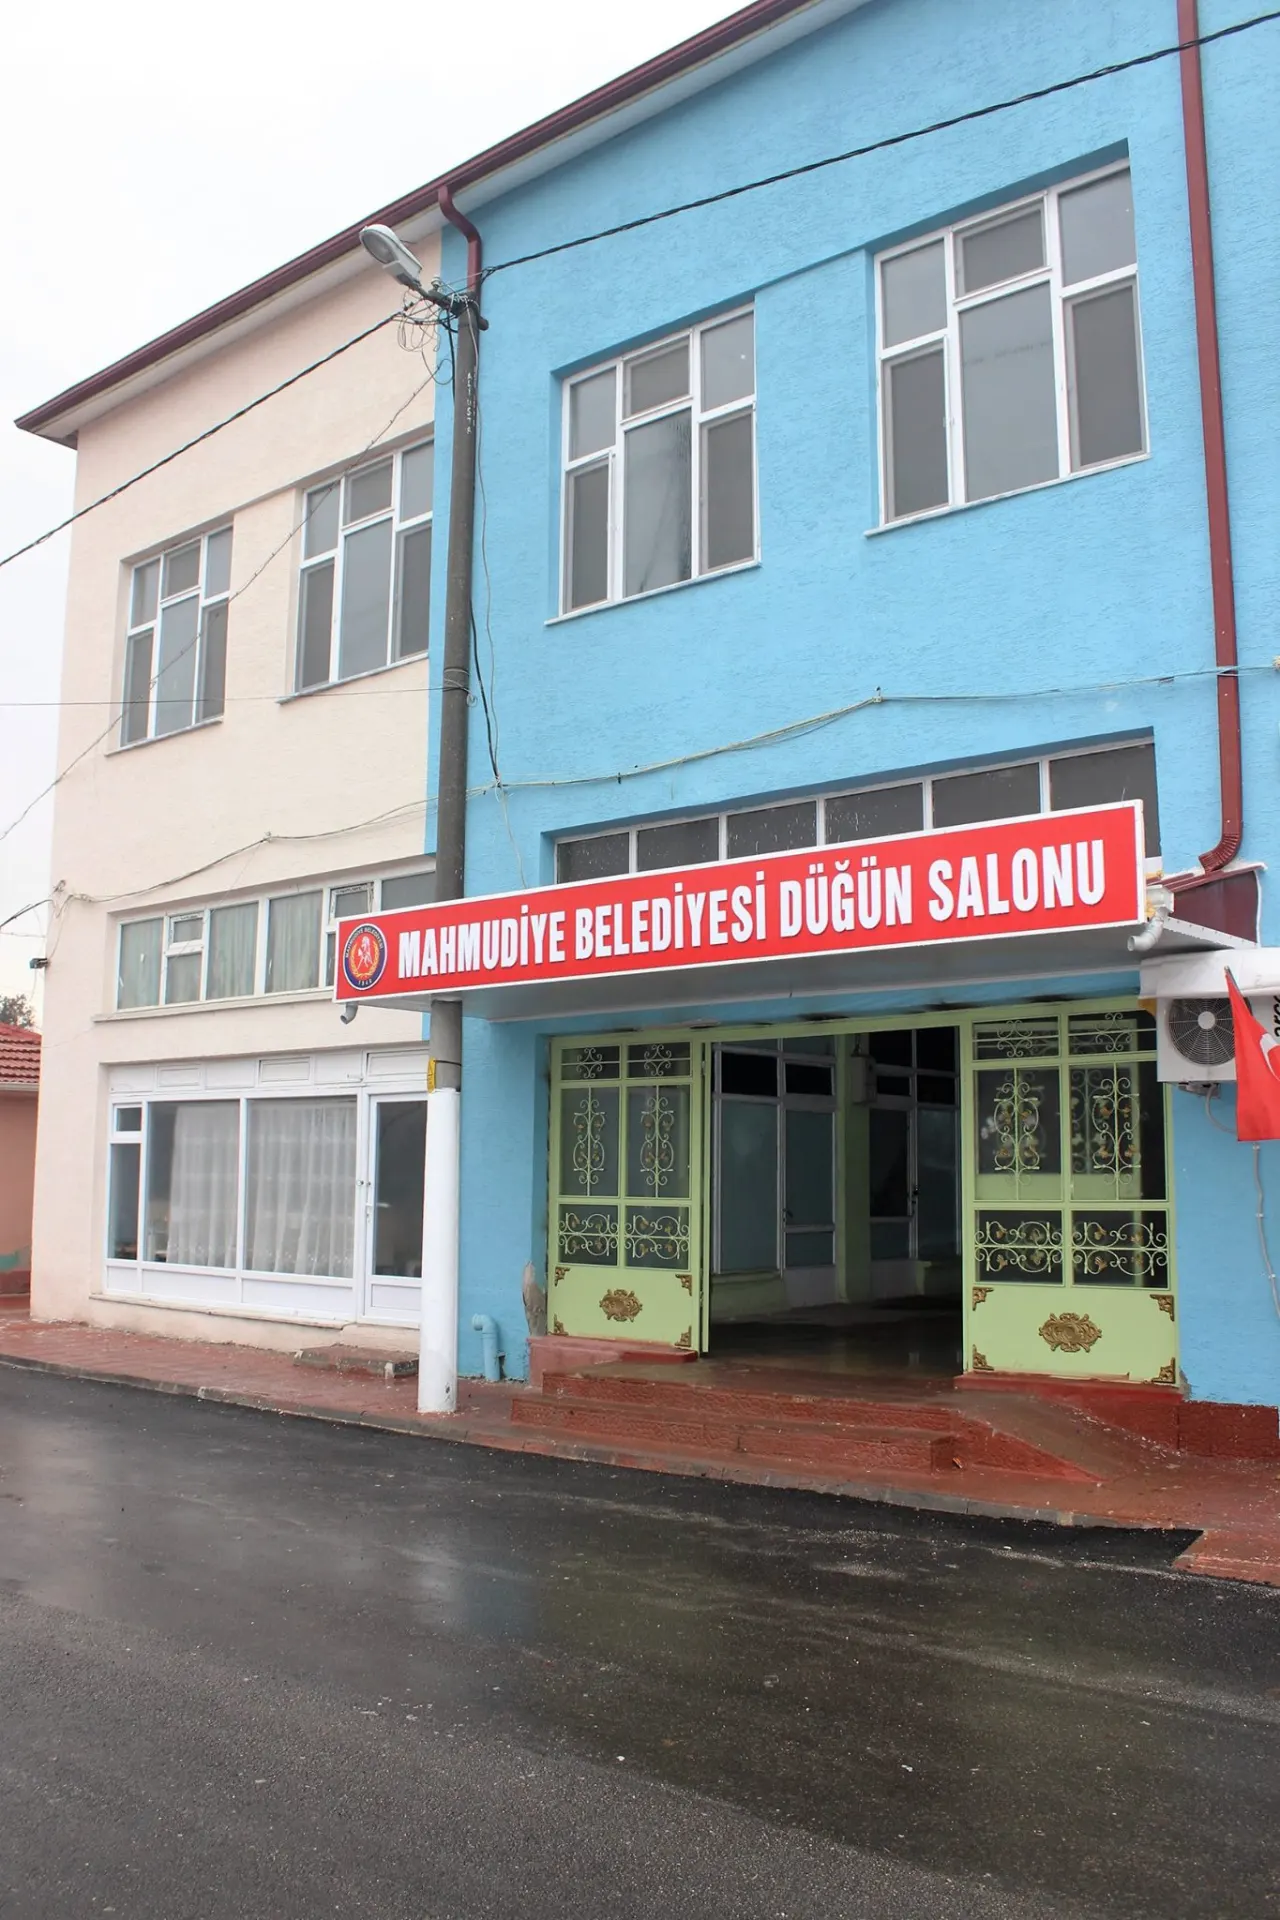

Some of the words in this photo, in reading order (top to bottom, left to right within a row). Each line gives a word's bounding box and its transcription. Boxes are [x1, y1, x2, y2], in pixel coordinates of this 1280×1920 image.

[398, 904, 566, 979] MAHMUDİYE
[575, 870, 766, 960] BELEDİYESİ
[779, 855, 913, 938] DÜĞÜN
[928, 839, 1106, 922] SALONU
